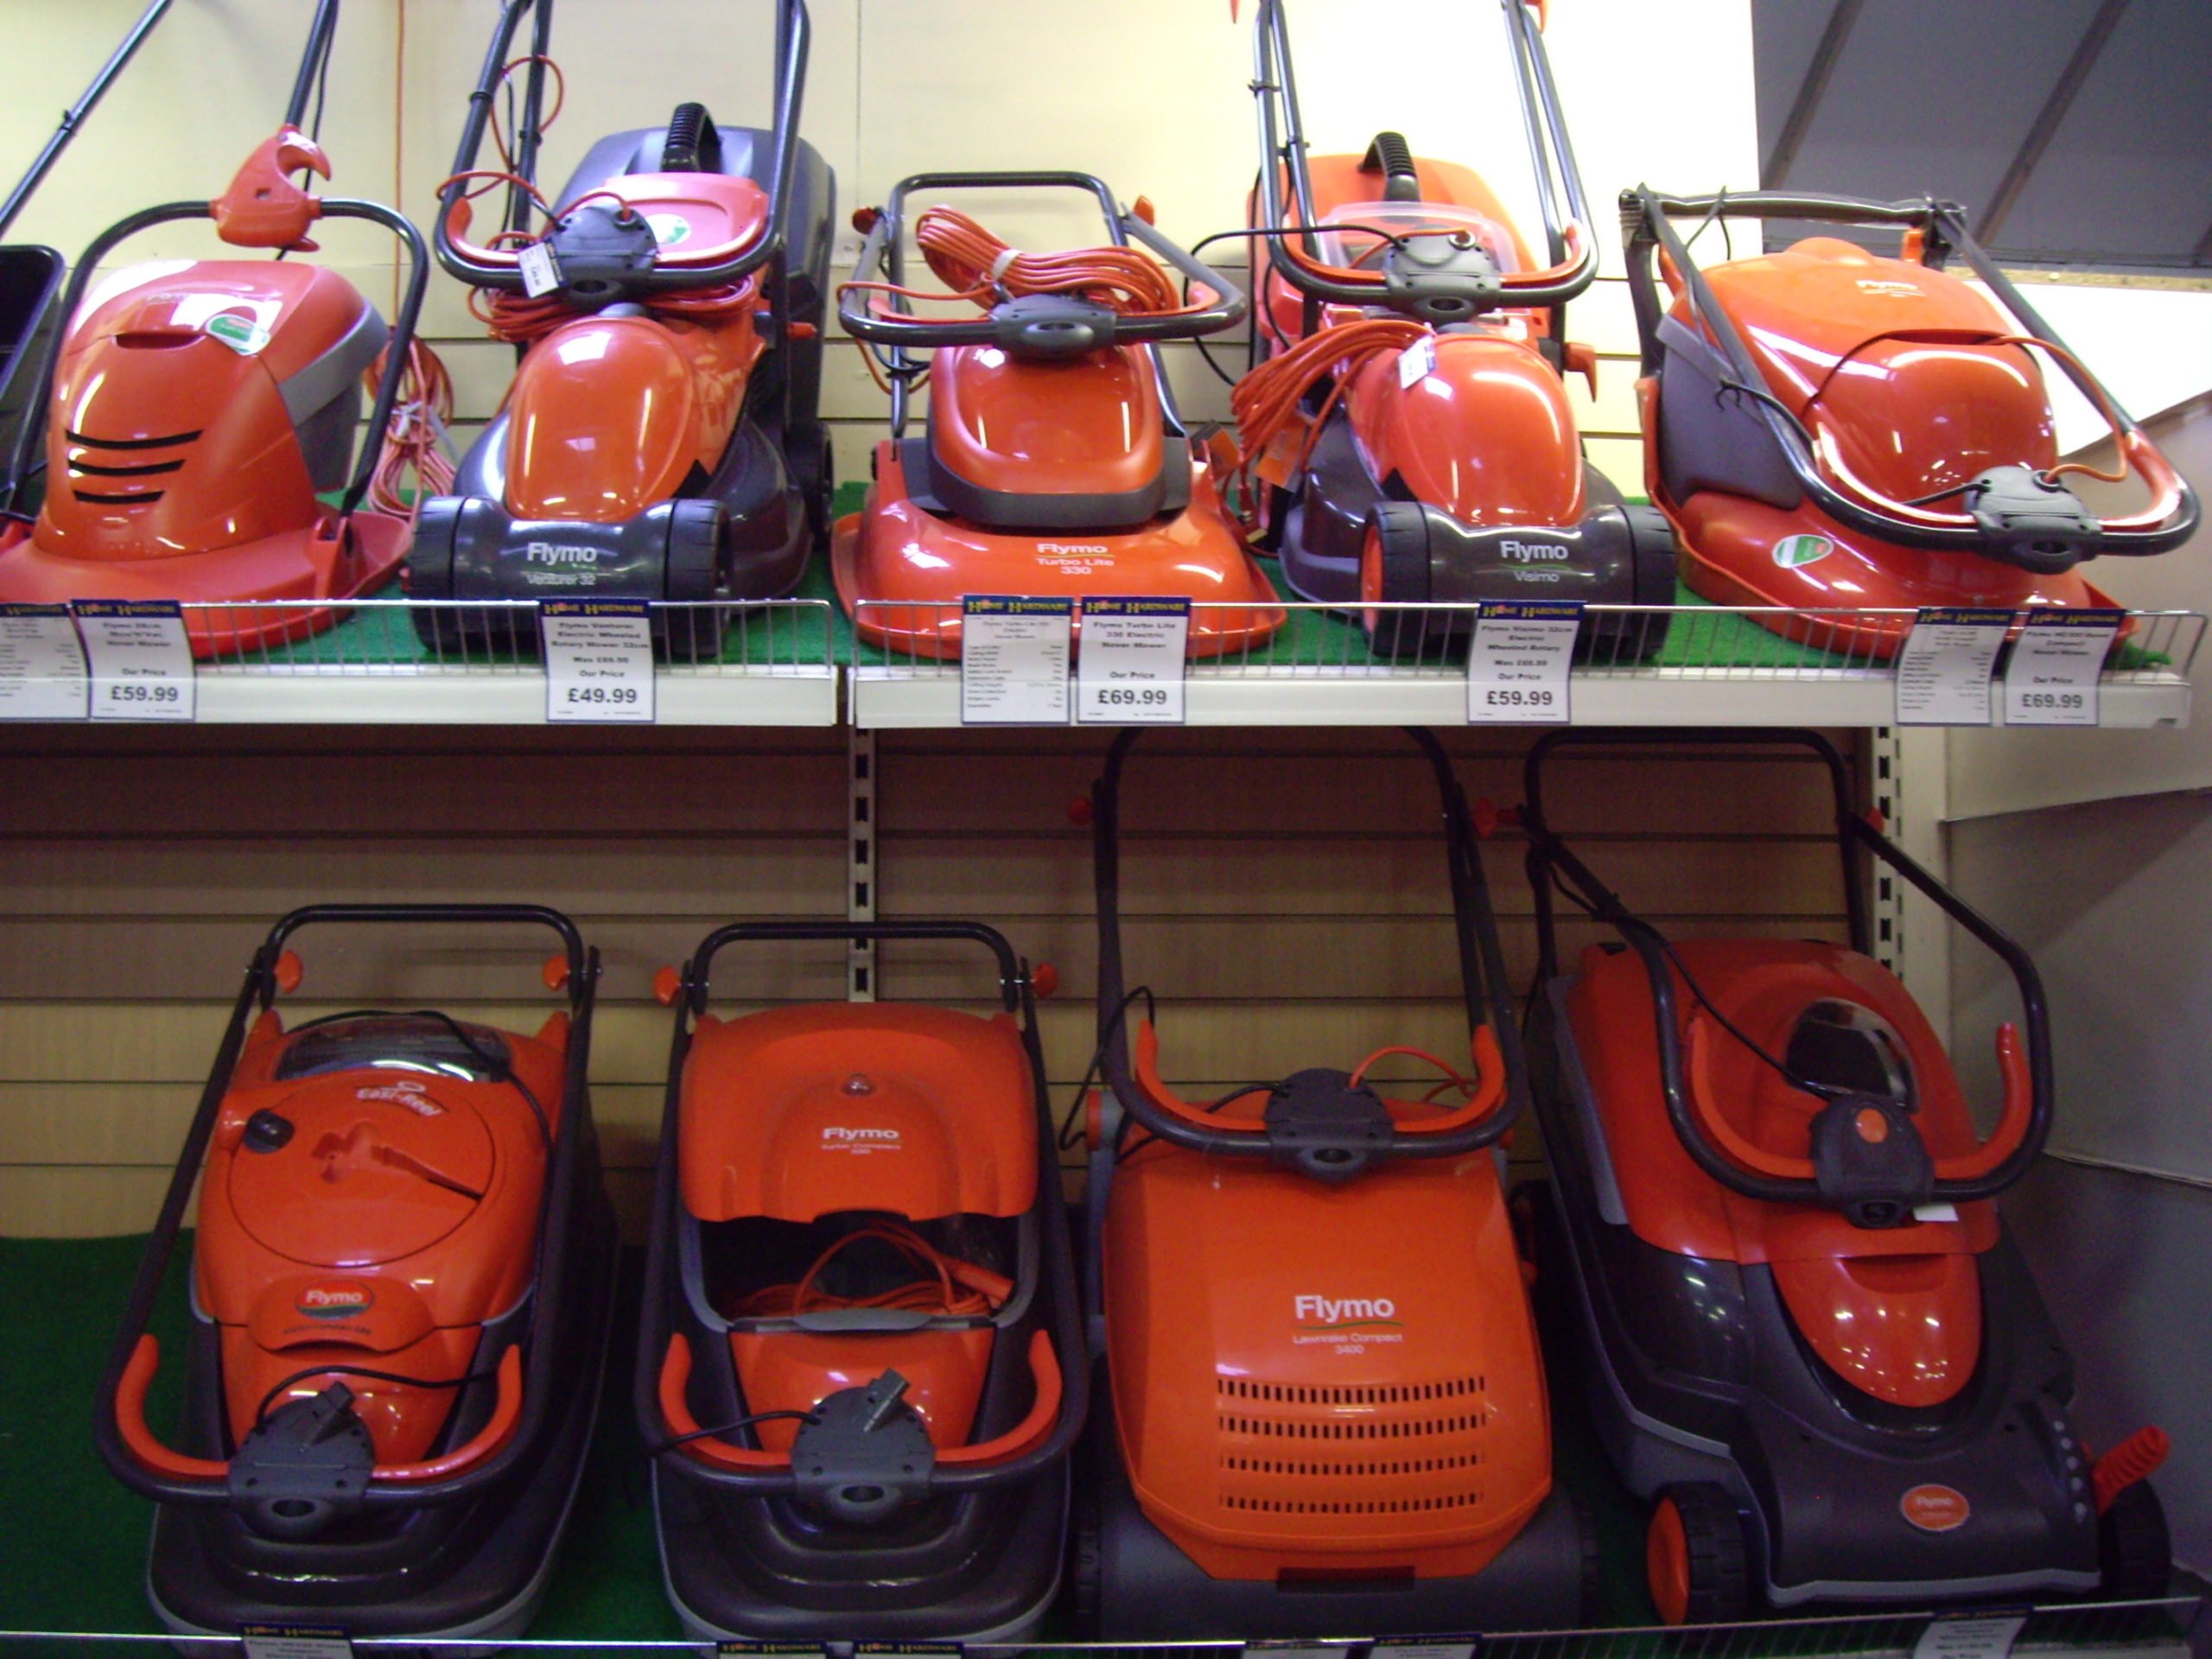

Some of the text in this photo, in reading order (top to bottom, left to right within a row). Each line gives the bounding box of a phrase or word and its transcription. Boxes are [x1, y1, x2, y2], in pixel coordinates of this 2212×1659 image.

[527, 542, 597, 566] Flymo
[1037, 543, 1109, 555] Flymo
[1500, 540, 1570, 563] Flymo
[1060, 567, 1093, 575] 330
[579, 573, 596, 586] 32
[111, 686, 179, 702] £59.99
[568, 688, 637, 703] £49.99
[1098, 690, 1167, 705] £69.99
[1487, 690, 1553, 706] £59.99
[2023, 694, 2082, 708] £69.99
[823, 1128, 899, 1141] Flymo
[306, 1289, 364, 1305] Flymo
[1295, 1295, 1395, 1323] Flymo
